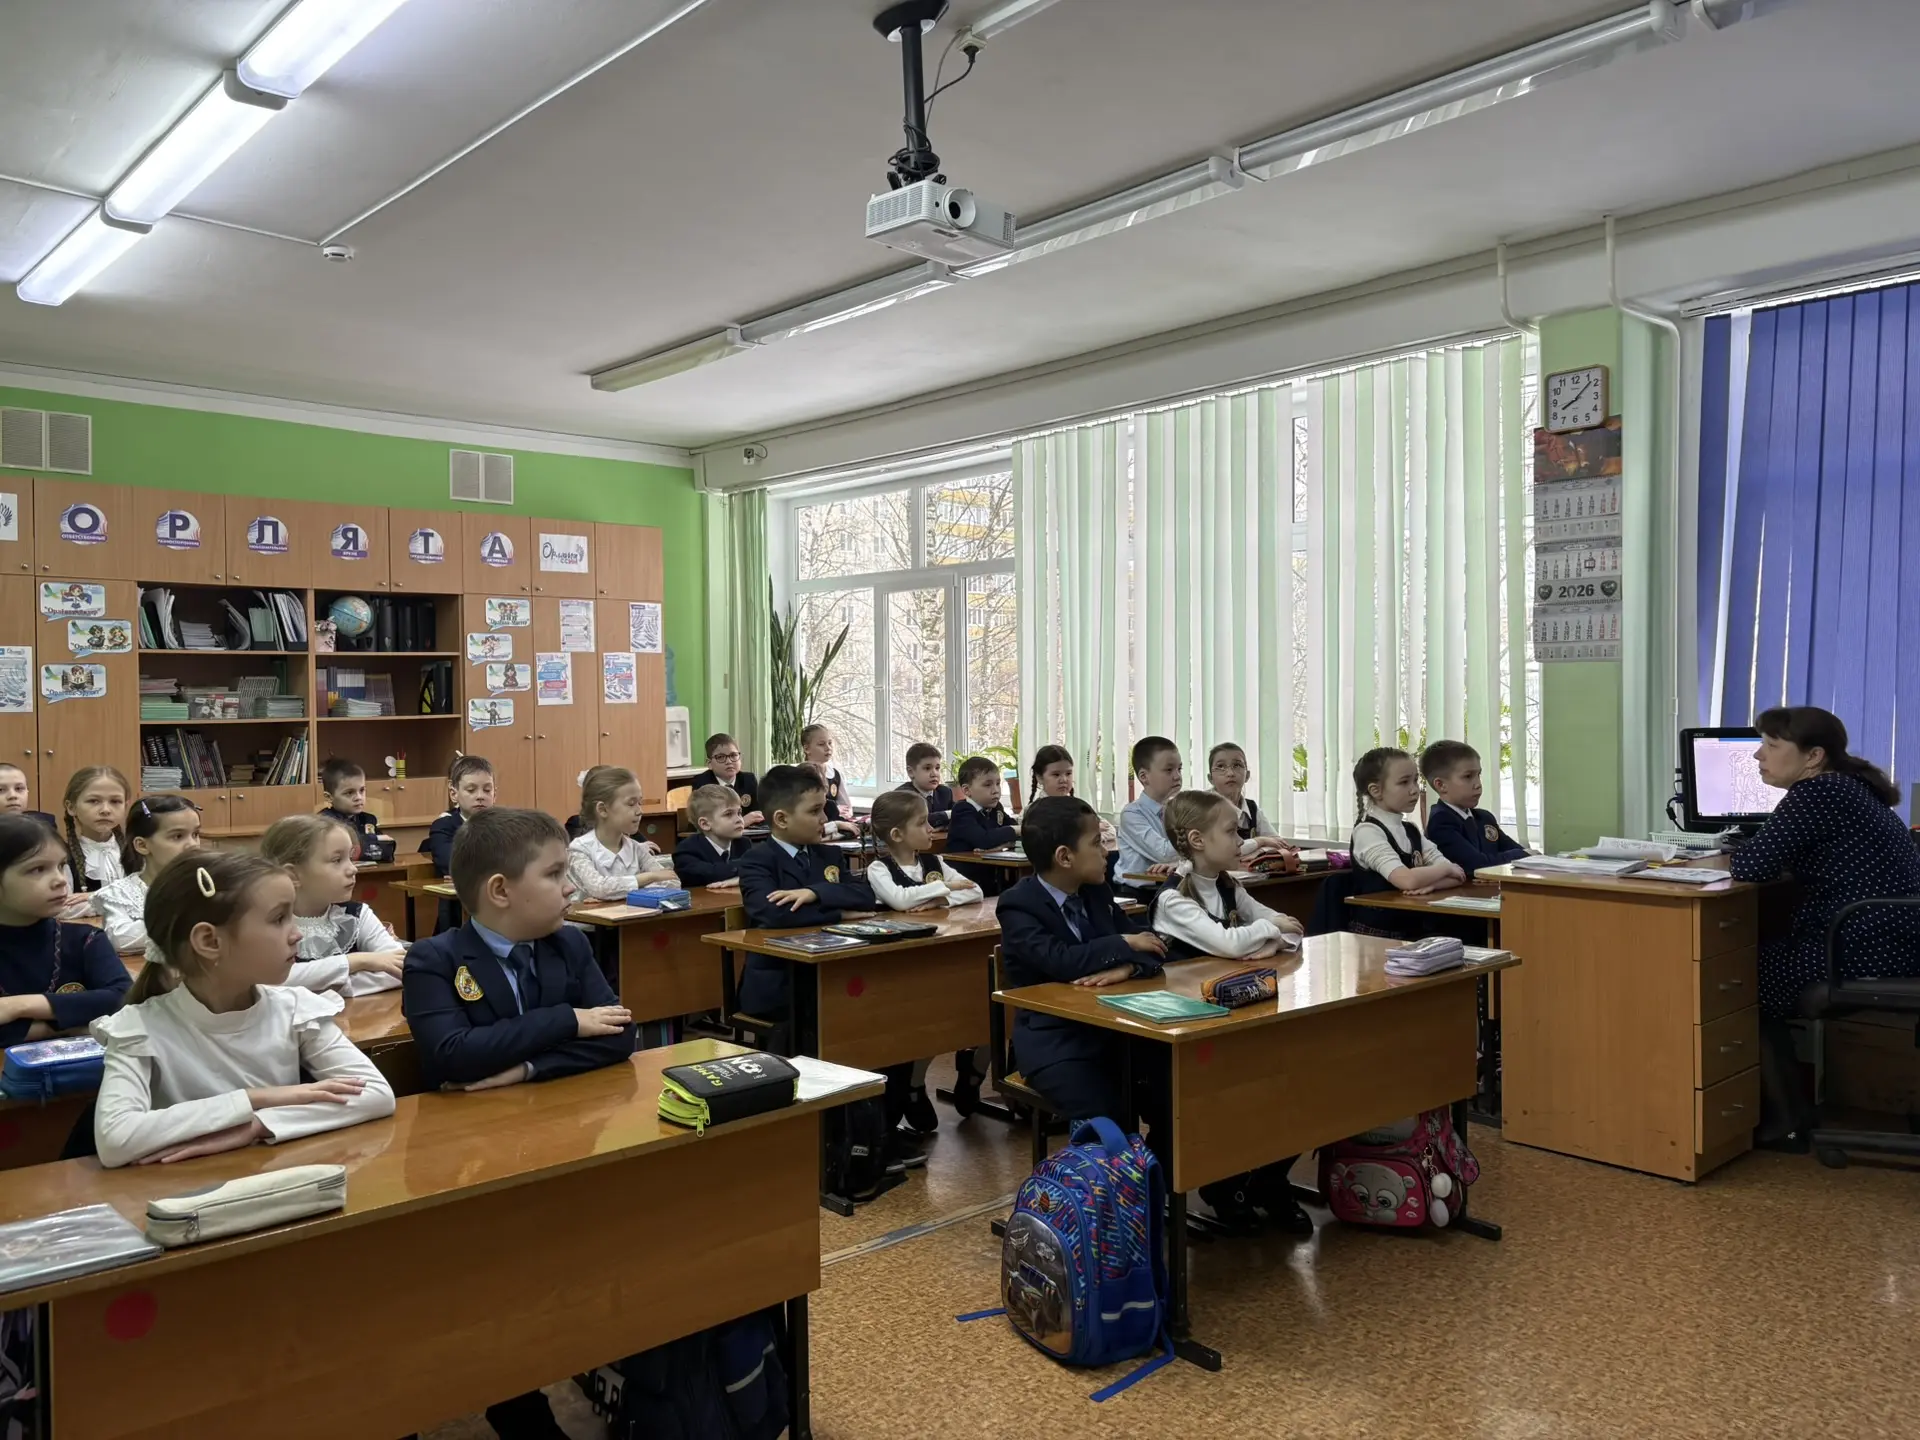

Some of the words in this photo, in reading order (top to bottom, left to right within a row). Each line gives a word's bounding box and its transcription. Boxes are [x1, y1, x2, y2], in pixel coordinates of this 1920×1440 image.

[1571, 375, 1580, 385] 12
[1586, 373, 1590, 381] 1
[1558, 378, 1566, 387] 11
[1593, 378, 1599, 387] 2
[1553, 387, 1561, 396] 10
[1593, 391, 1599, 400] 3
[1552, 399, 1558, 407] 9
[1592, 404, 1598, 412] 4
[1552, 412, 1558, 420] 8
[1561, 416, 1567, 424] 7
[1572, 415, 1578, 423] 6
[1585, 413, 1590, 422] 5
[67, 506, 100, 534] О
[169, 513, 190, 538] Р
[255, 520, 279, 544] Л
[340, 527, 359, 550] Я
[418, 531, 434, 554] Т
[487, 536, 507, 558] А
[1559, 584, 1594, 598] 2026
